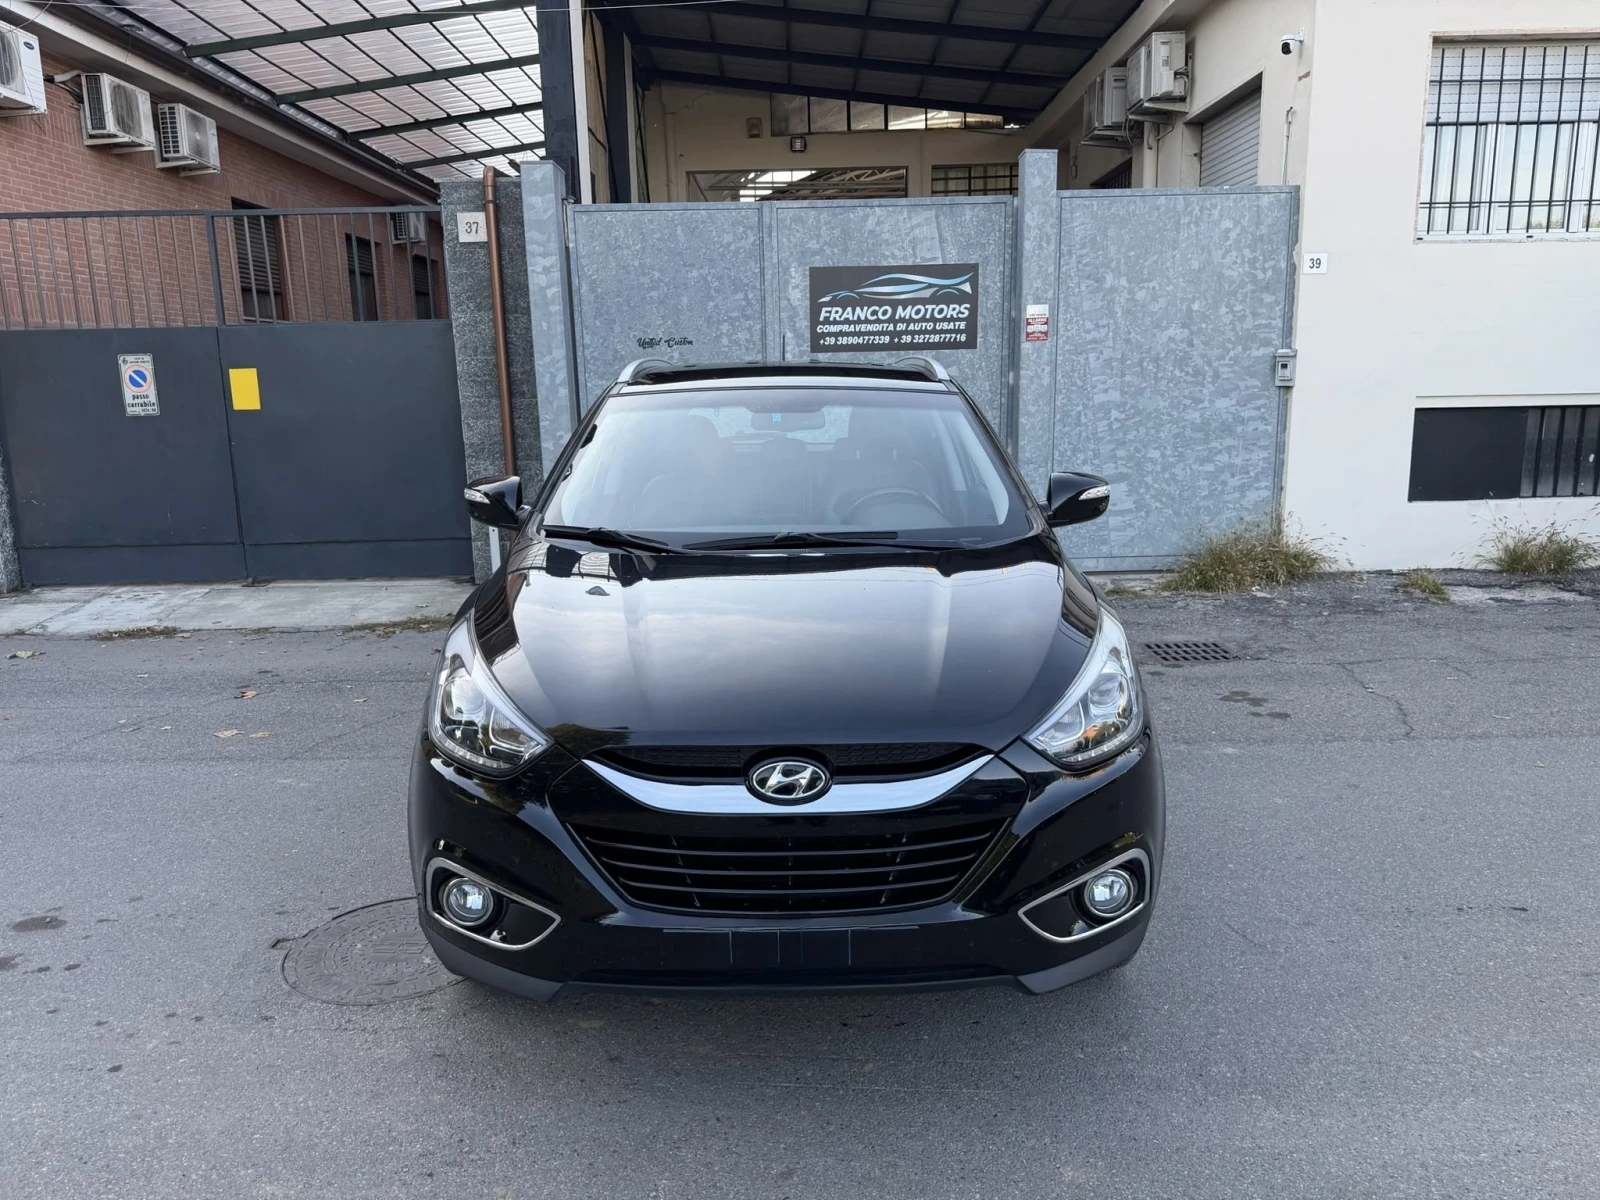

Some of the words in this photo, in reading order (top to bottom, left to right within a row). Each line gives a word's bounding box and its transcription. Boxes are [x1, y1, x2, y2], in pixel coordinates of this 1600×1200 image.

[465, 221, 479, 234] 37
[1309, 257, 1321, 269] 39
[819, 305, 893, 321] FRANCO
[895, 303, 971, 320] MOTORS
[816, 323, 894, 333] COMPRAVENDITA
[896, 323, 907, 331] DI
[907, 322, 934, 331] AUTO
[935, 321, 967, 330] USATE
[819, 337, 836, 345] +39
[836, 335, 890, 345] 3890477339
[900, 335, 912, 343] 39
[912, 333, 967, 343] 3272877716
[127, 400, 156, 408] carrabile
